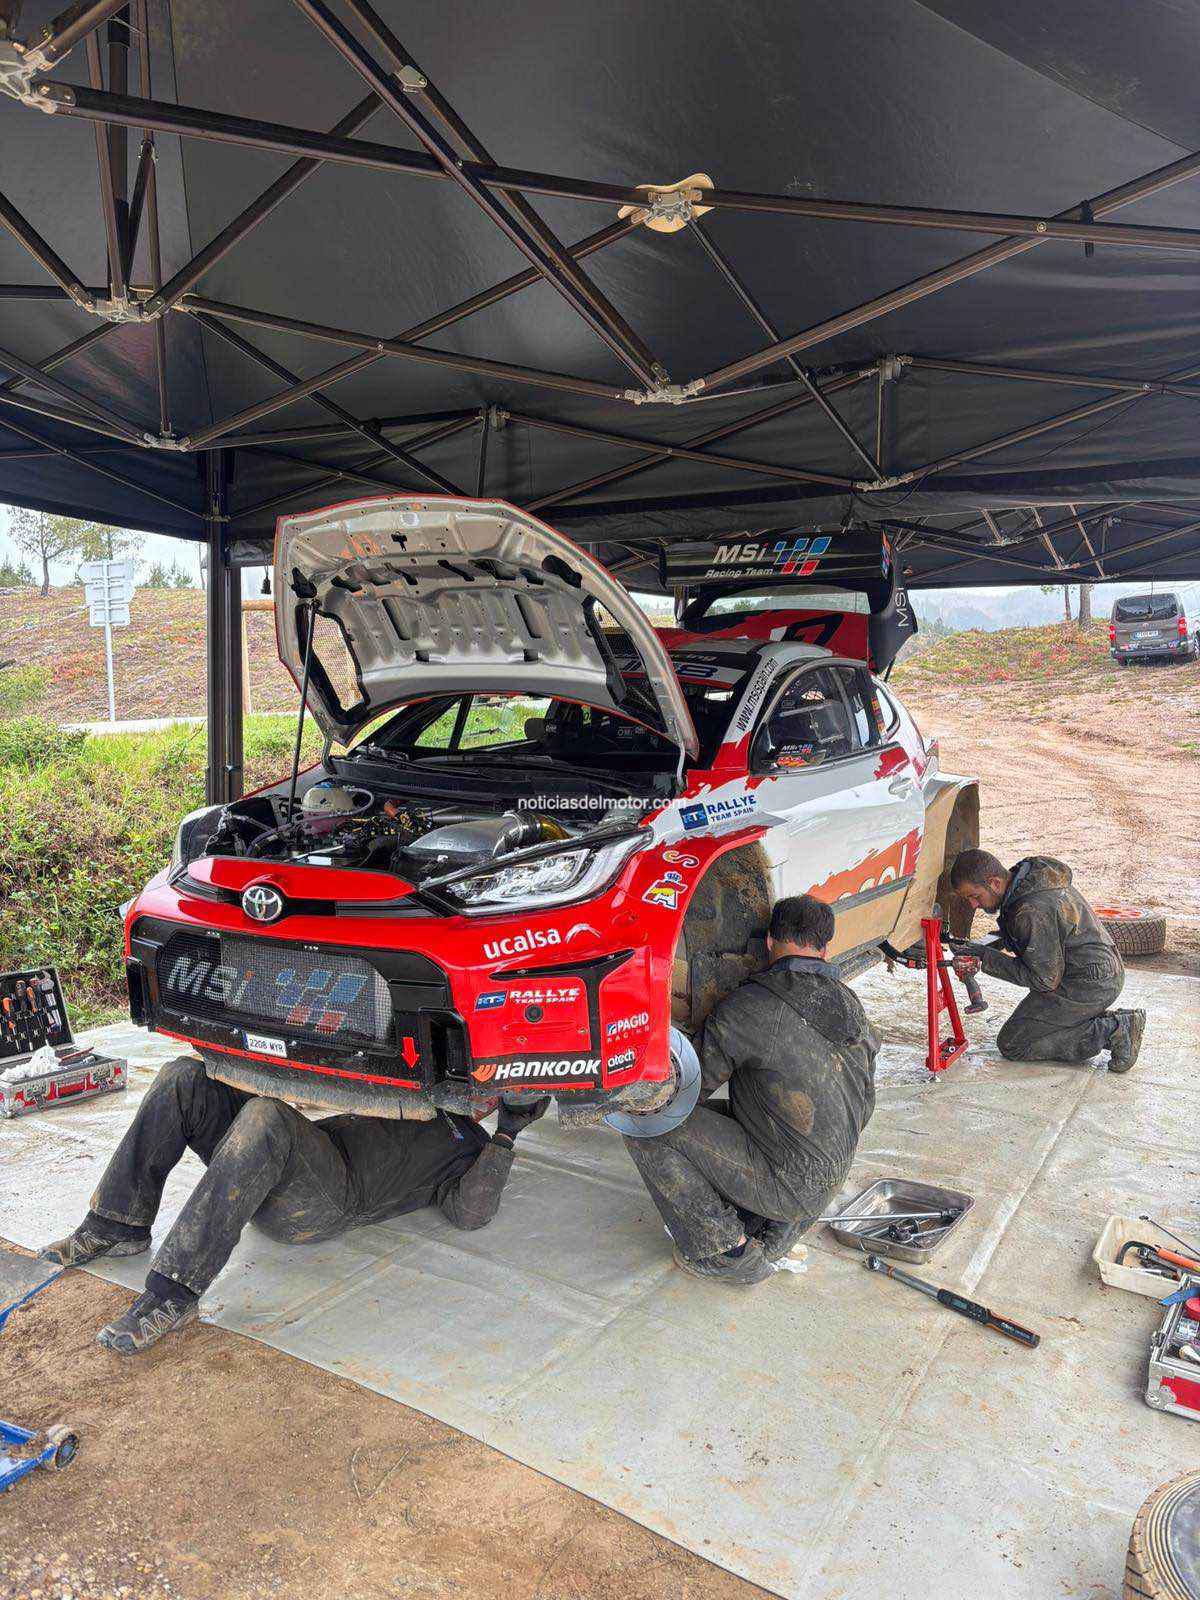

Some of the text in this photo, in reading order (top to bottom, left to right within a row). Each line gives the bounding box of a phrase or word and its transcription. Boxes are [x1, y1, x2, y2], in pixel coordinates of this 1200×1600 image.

[704, 569, 742, 579] Racing
[706, 795, 757, 814] RALLYE
[711, 806, 754, 822] TEAM SPAIN
[483, 929, 562, 960] ucalsa
[510, 986, 579, 998] RALLYE
[545, 995, 577, 1003] SPAIN
[617, 1011, 649, 1032] PAGID
